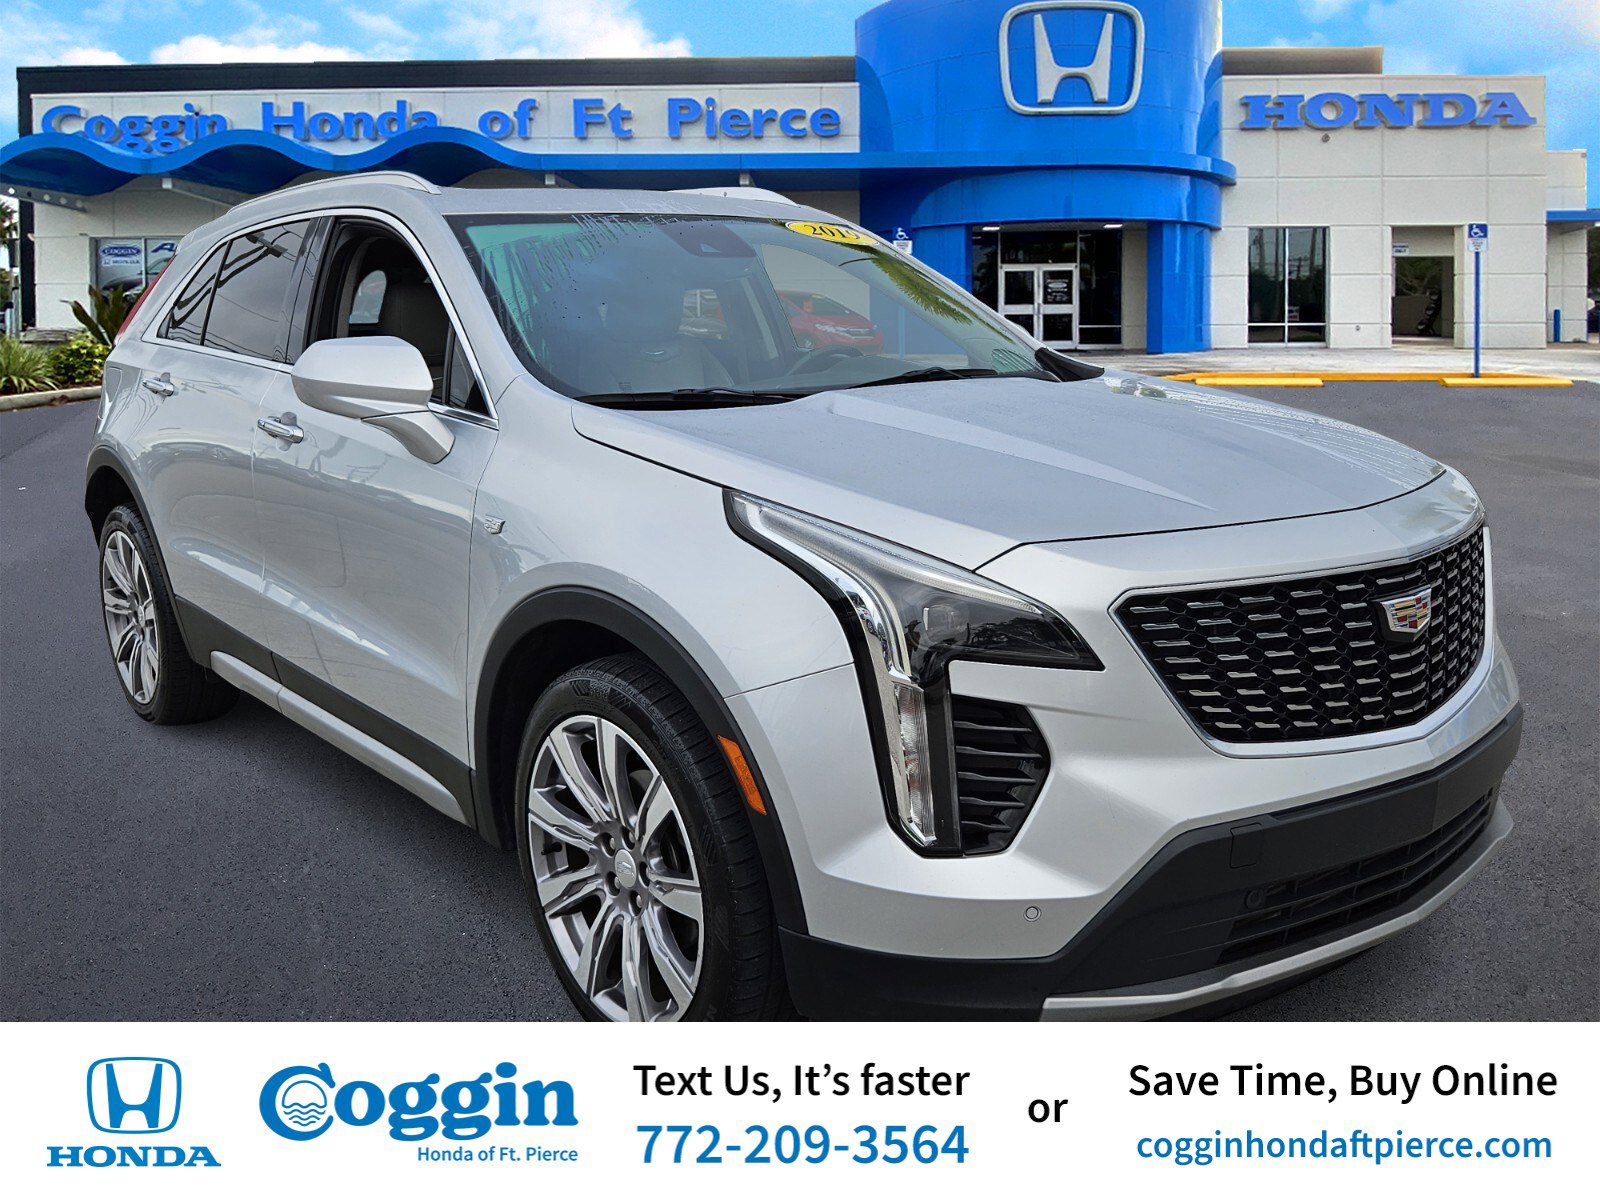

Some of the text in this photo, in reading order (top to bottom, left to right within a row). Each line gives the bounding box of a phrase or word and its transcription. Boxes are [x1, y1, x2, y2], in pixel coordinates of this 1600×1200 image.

[41, 97, 842, 155] Coggin Honda of Ft Pierce
[1241, 92, 1537, 129] HONDA
